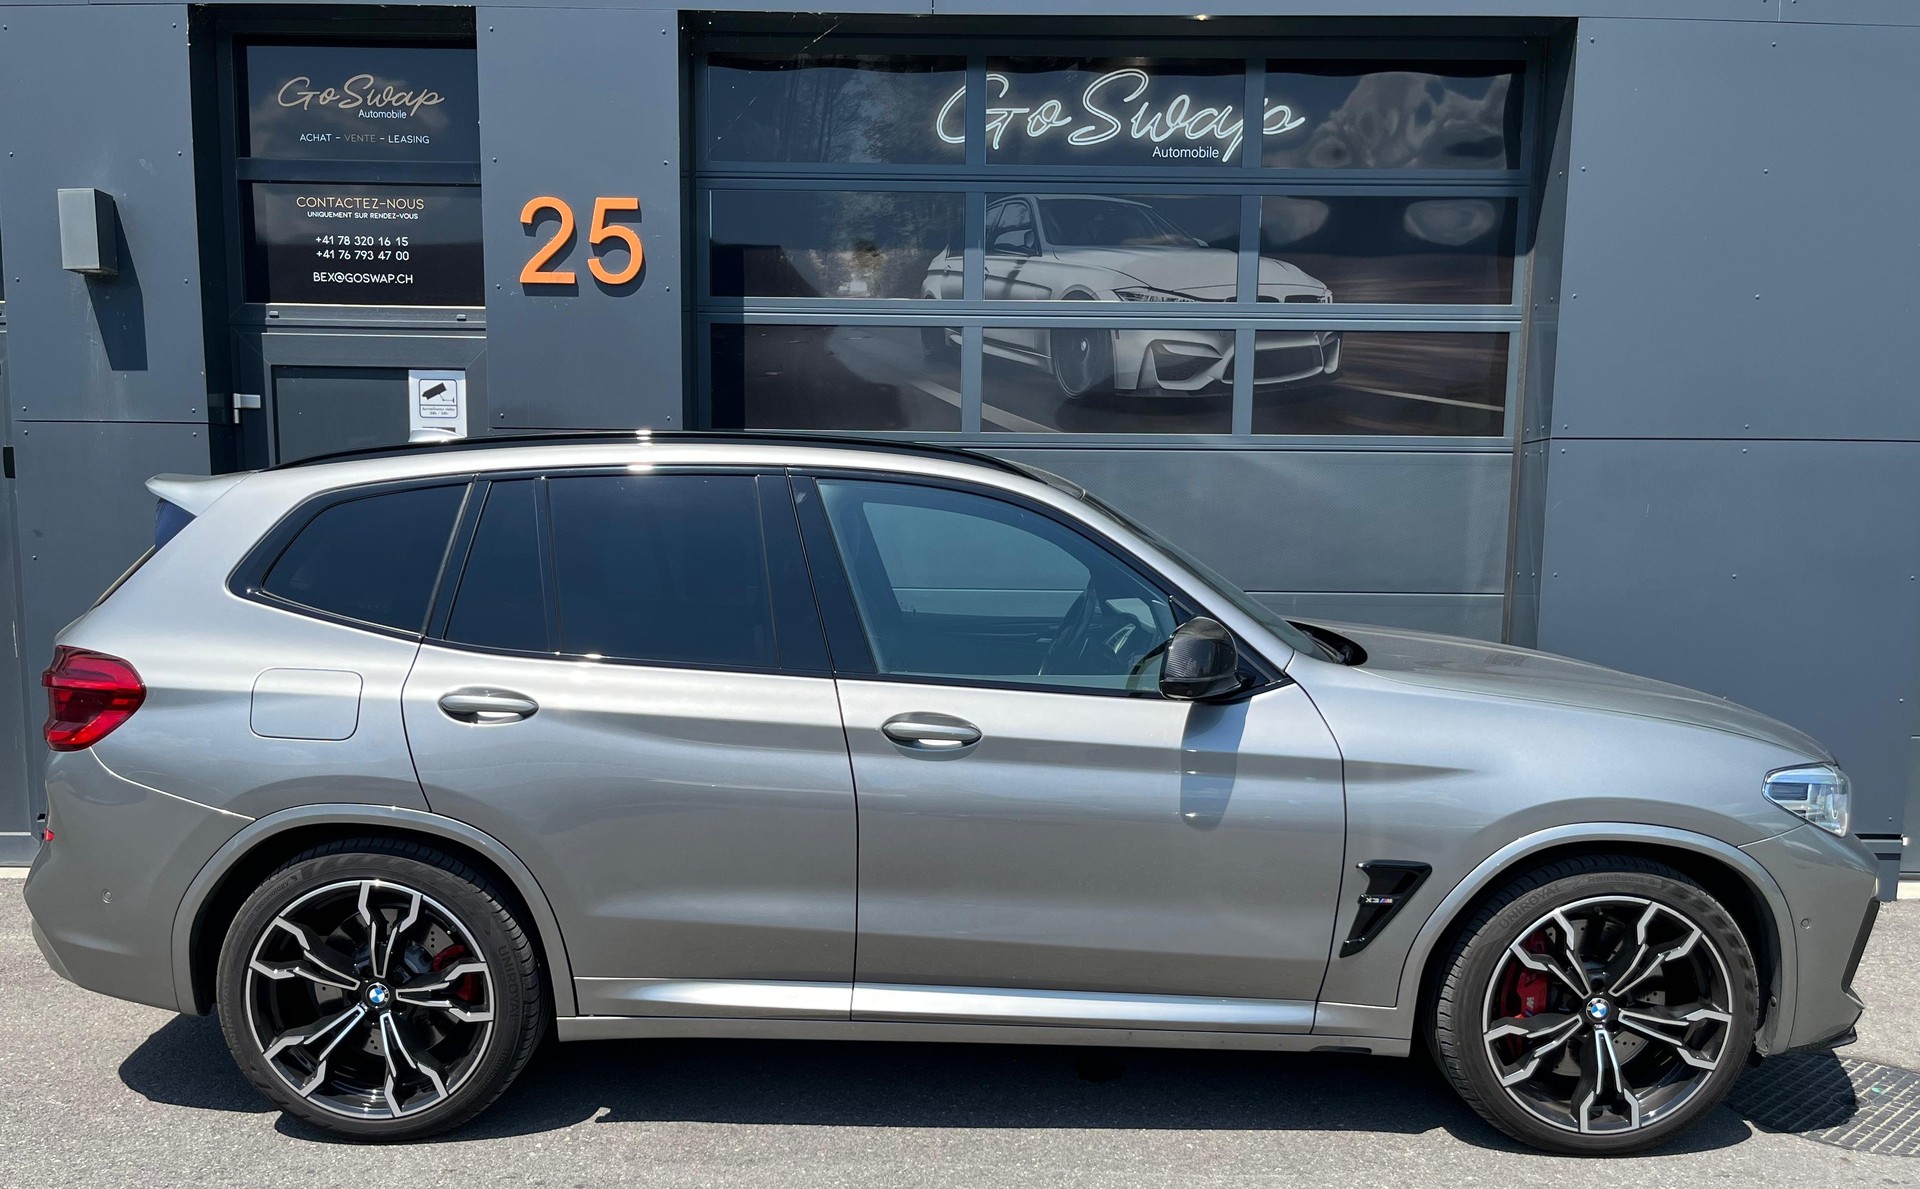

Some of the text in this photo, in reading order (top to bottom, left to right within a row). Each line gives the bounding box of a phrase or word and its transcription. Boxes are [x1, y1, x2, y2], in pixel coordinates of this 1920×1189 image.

[358, 108, 407, 119] Automobile
[299, 133, 332, 142] ACHAT
[344, 134, 376, 143] VENTE
[388, 134, 430, 144] LEASING
[1152, 145, 1220, 159] Automobile
[296, 196, 425, 210] CONTACTEZ-NOUS
[307, 211, 353, 219] UNIQUEMENT
[369, 212, 419, 220] RENDEZ-VOUS
[315, 235, 409, 247] +41 78 320 16 15
[520, 196, 643, 285] 25
[316, 249, 410, 261] +41 76 793 47 00
[313, 271, 414, 284] BEX@GOSWAP.CH
[1499, 884, 1563, 929] UNIROYAL
[498, 945, 520, 1017] UNIROYAL
